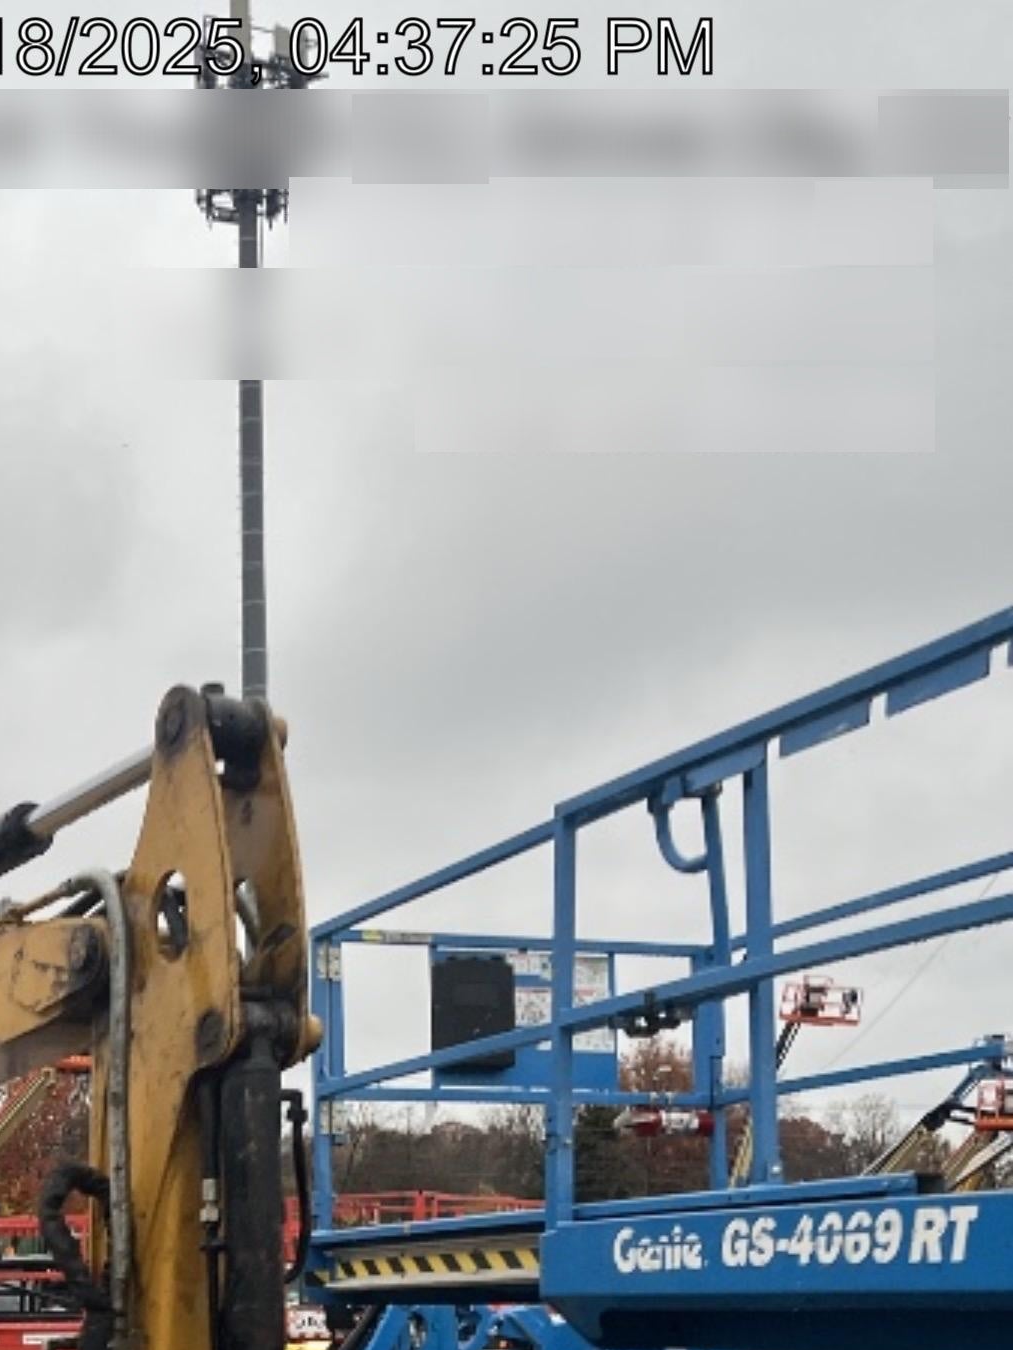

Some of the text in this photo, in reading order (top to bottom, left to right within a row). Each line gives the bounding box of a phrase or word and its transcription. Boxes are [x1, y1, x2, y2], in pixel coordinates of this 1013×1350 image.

[612, 1204, 980, 1275] Genie GS-4069 RT
